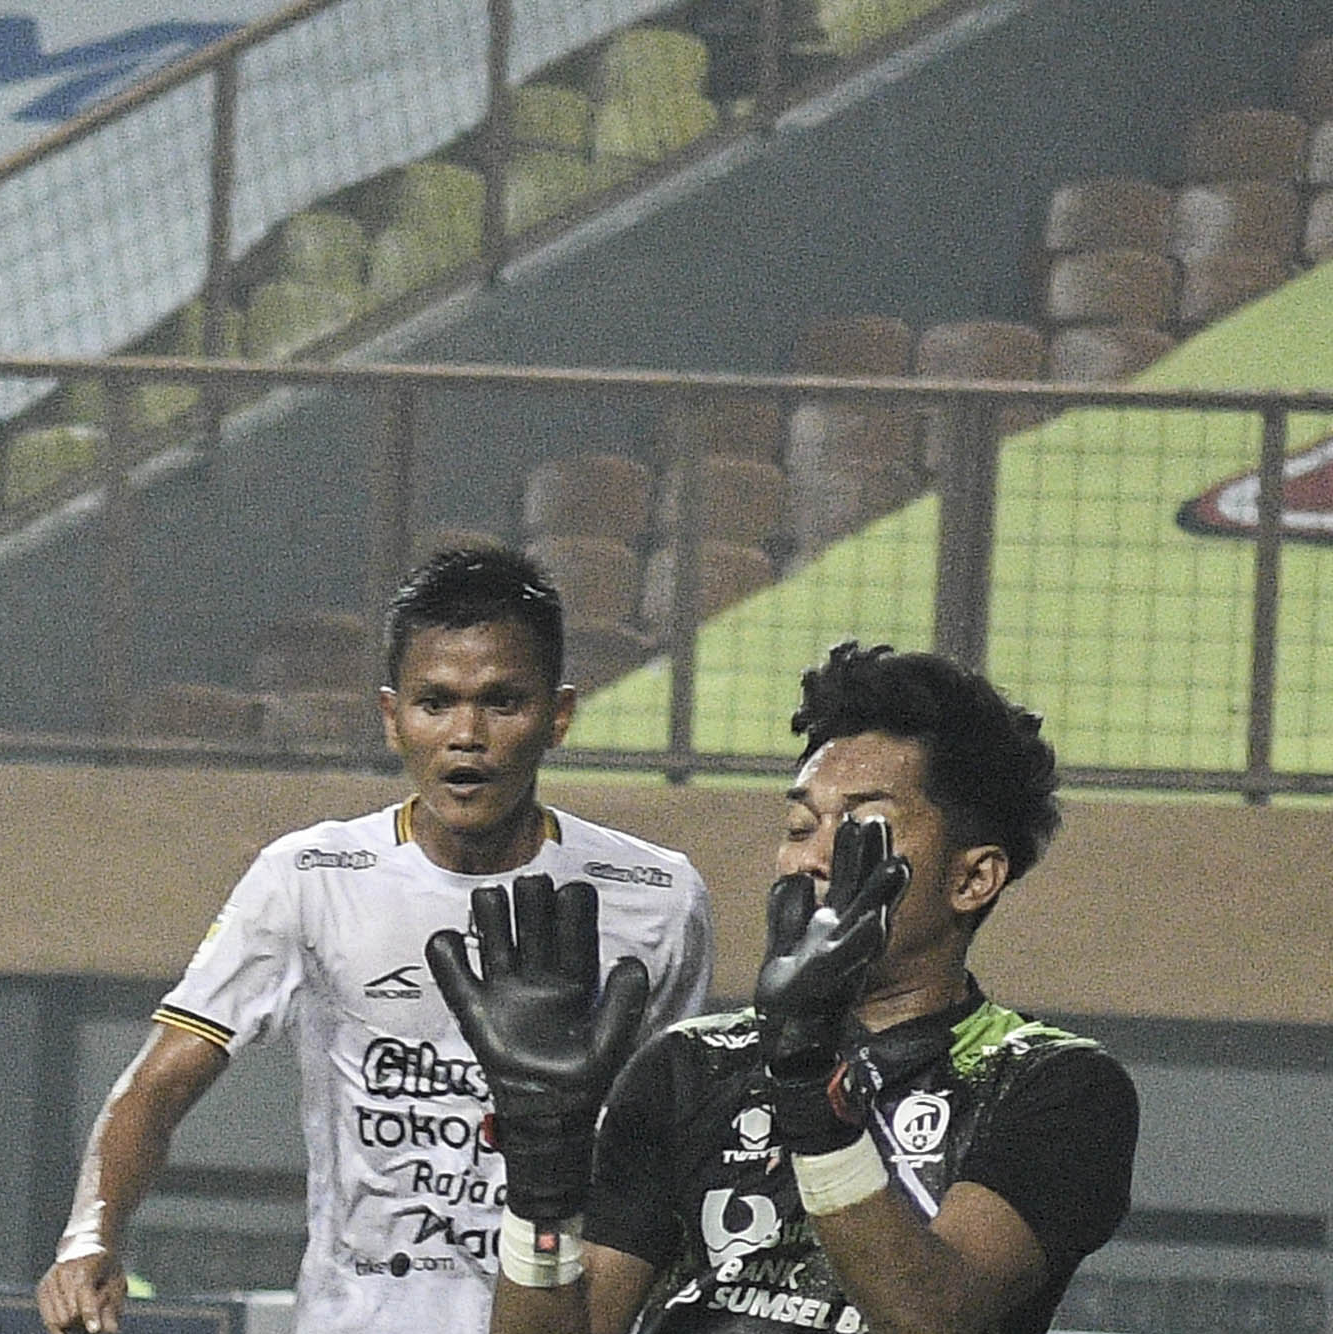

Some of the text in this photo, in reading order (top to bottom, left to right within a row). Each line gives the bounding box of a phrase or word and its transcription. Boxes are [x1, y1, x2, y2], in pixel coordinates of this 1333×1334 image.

[361, 1037, 494, 1101] Gilus
[716, 1258, 806, 1290] BANK
[707, 1286, 832, 1331] SUMSEL
